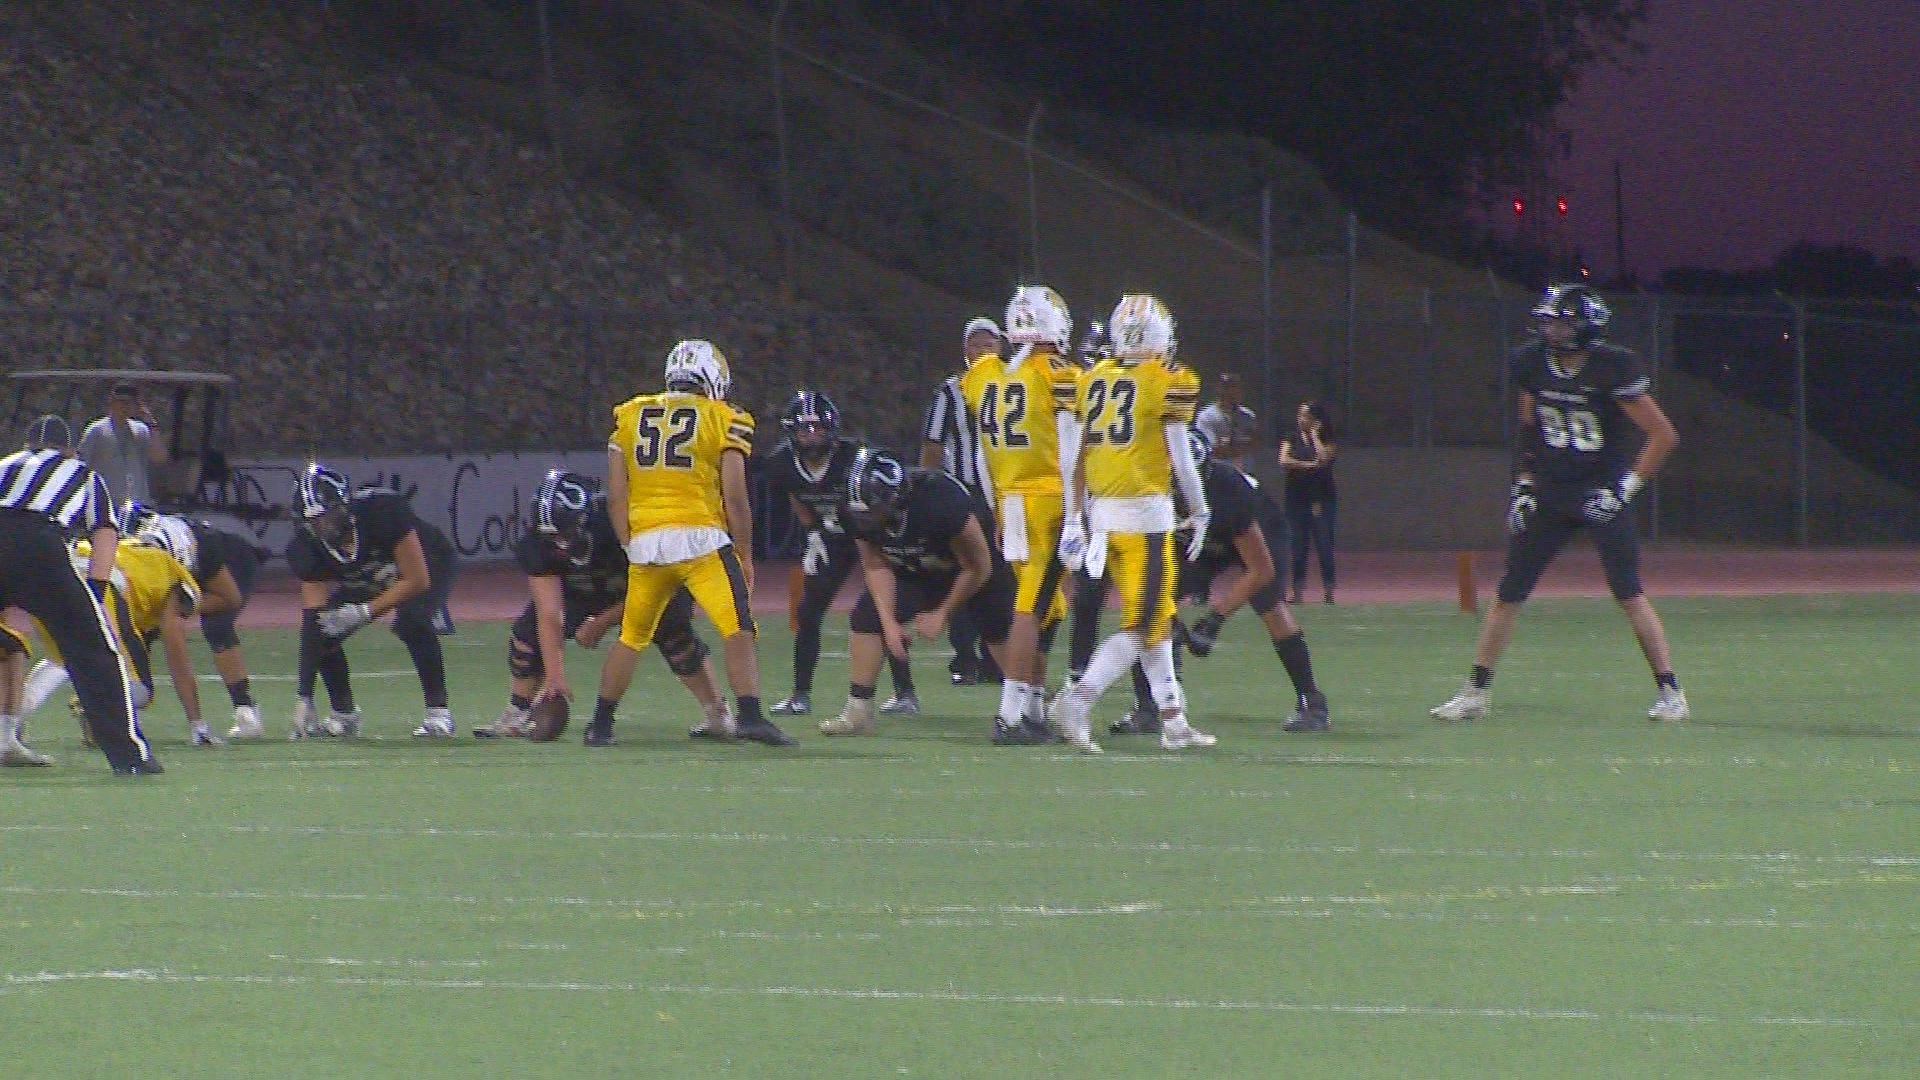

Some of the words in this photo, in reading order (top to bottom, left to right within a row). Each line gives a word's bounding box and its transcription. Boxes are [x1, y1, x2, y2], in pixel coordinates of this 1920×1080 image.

[635, 406, 699, 470] 52
[978, 382, 1032, 449] 42
[1084, 377, 1137, 447] 23
